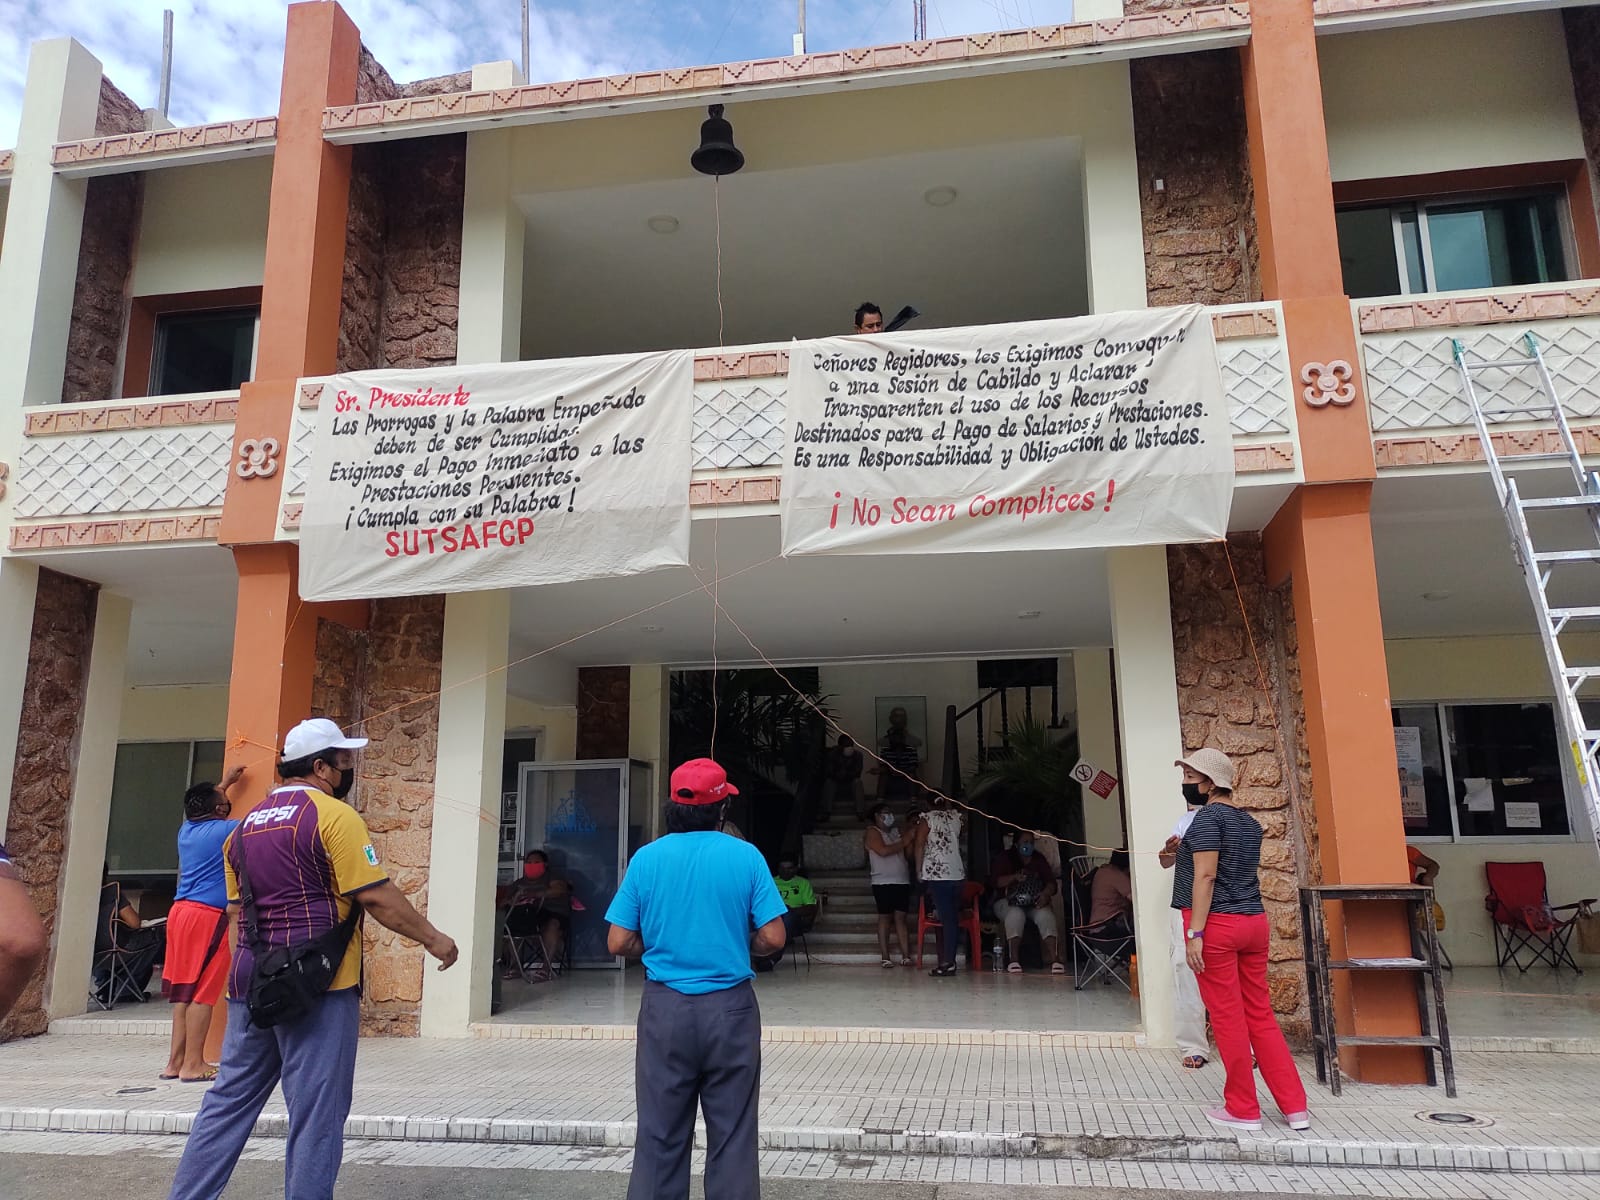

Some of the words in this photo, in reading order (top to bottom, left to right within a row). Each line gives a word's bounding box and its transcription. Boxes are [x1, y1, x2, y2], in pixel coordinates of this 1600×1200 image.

[884, 349, 967, 376] Regidores,
[975, 348, 1000, 364] les
[1007, 343, 1083, 368] Exigimos
[1094, 327, 1186, 358] Convoqun
[828, 381, 840, 393] a
[847, 380, 880, 396] una
[888, 372, 939, 395] Sesión
[947, 370, 968, 392] de
[976, 366, 1041, 391] Cabildo
[1049, 370, 1061, 390] y
[1067, 362, 1137, 384] Aclarar
[335, 390, 361, 412] Sr.
[369, 384, 471, 410] Presidente
[823, 397, 943, 423] Transparenten
[950, 395, 965, 415] el
[971, 397, 1001, 414] uso
[1010, 390, 1030, 411] de
[1037, 390, 1062, 410] los
[1071, 377, 1149, 408] Recursos
[332, 416, 358, 436] Las
[365, 413, 437, 436] Prorrogas
[444, 414, 454, 434] y
[461, 408, 477, 426] la
[483, 405, 546, 425] Palabra
[793, 421, 881, 444] Destinados
[885, 426, 923, 448] para
[931, 421, 946, 441] el
[953, 419, 991, 446] Pago
[998, 416, 1017, 438] de
[1023, 413, 1090, 437] Salarios
[1092, 411, 1104, 430] y
[1108, 399, 1209, 424] Prestaciones.
[374, 435, 416, 455] deben
[427, 432, 445, 452] de
[454, 435, 483, 451] ser
[793, 446, 812, 468] Es
[817, 452, 850, 468] una
[858, 442, 993, 472] Responsabilidad
[1001, 449, 1013, 470] y
[1019, 430, 1104, 463] Obligación
[1109, 427, 1128, 451] de
[1135, 422, 1206, 450] Ustedes.
[329, 461, 405, 487] Exigimos
[414, 456, 430, 477] el
[438, 455, 477, 480] Pago
[485, 440, 580, 471] Inmeiato
[590, 444, 602, 457] a
[612, 433, 645, 456] las
[361, 478, 471, 503] Prestaciones
[429, 506, 457, 524] con
[464, 502, 483, 519] su
[890, 496, 956, 525] Sean
[385, 517, 535, 557] SUTSAFCP
[244, 805, 299, 828] PEPSI
